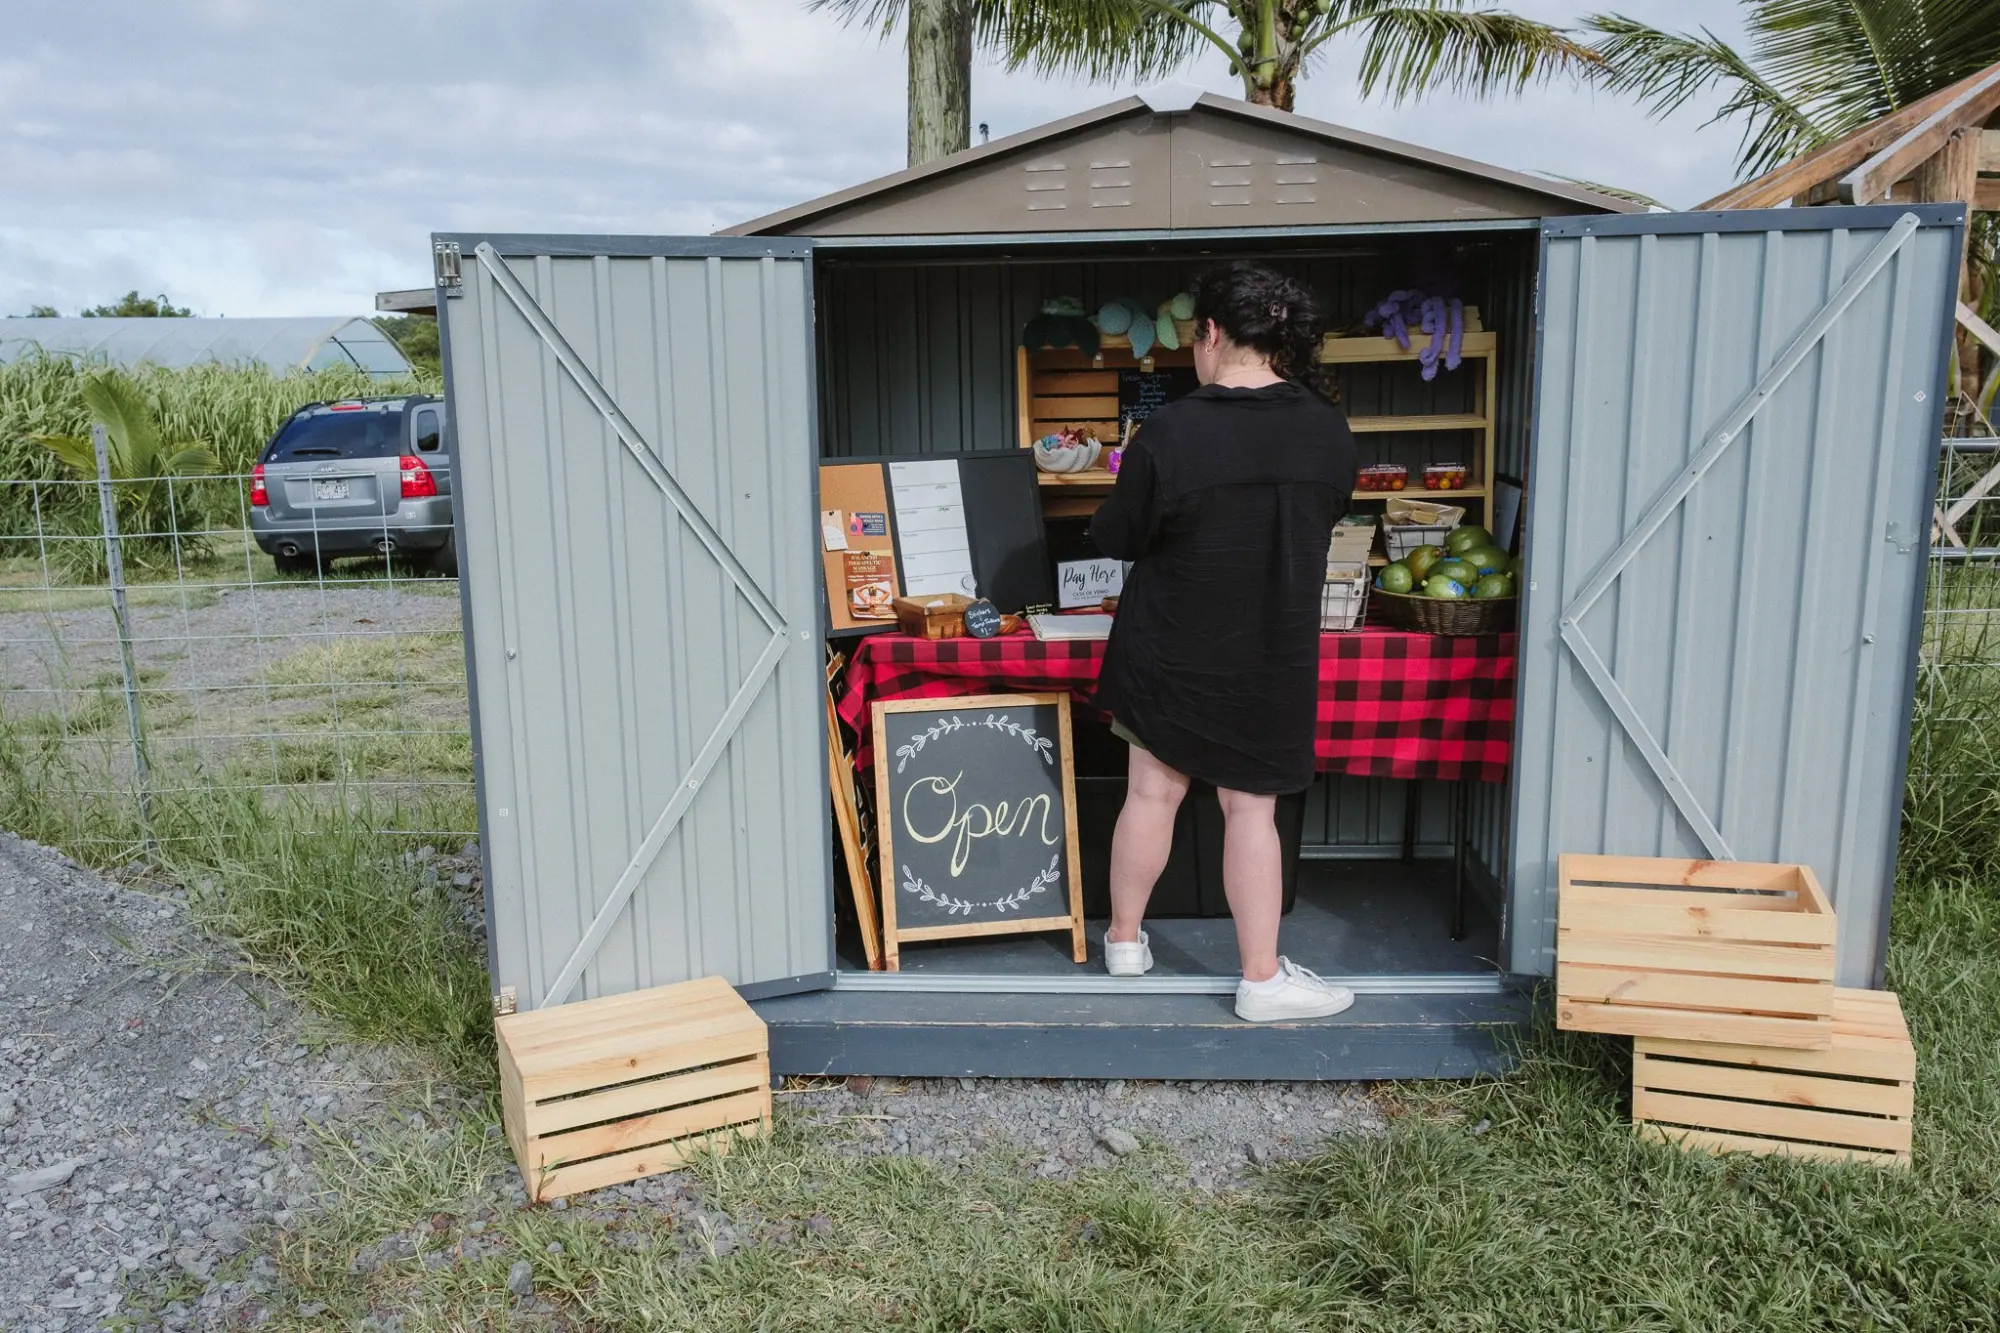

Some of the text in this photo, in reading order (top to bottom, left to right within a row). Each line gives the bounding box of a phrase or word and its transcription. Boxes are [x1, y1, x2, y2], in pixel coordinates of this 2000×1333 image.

[1063, 566, 1086, 591] Pay
[1089, 564, 1117, 583] Here
[968, 608, 991, 619] Stickers
[903, 770, 1059, 878] Open
